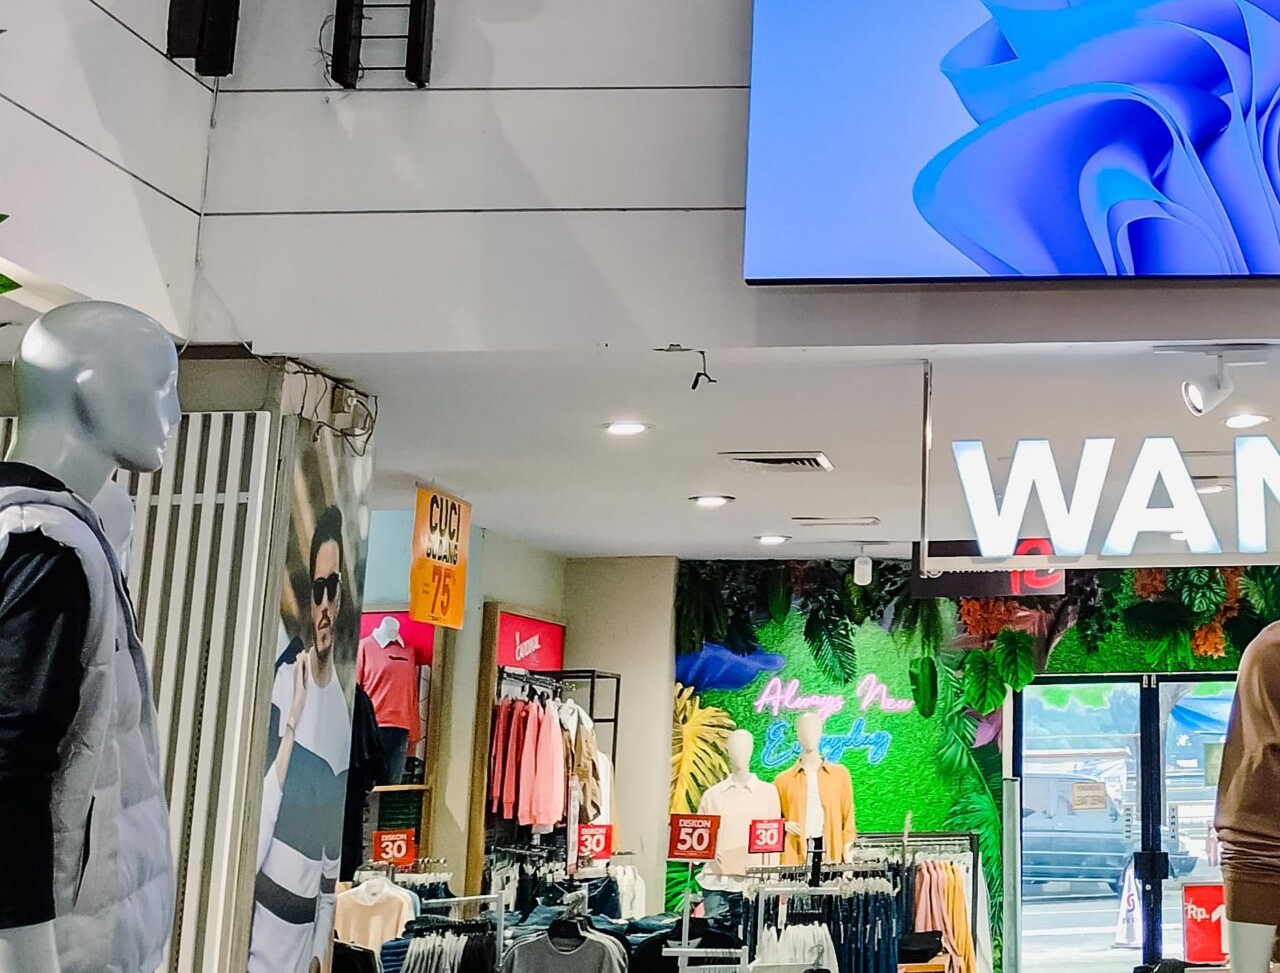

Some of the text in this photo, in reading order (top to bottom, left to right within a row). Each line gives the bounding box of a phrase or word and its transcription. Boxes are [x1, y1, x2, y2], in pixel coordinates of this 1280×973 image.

[429, 494, 461, 543] CUCI
[753, 673, 915, 720] Always New
[679, 818, 712, 828] DISKON
[580, 834, 606, 853] 30
[677, 827, 710, 851] 50
[755, 829, 779, 846] 30
[380, 841, 407, 859] 30
[1186, 903, 1210, 923] Rp.
